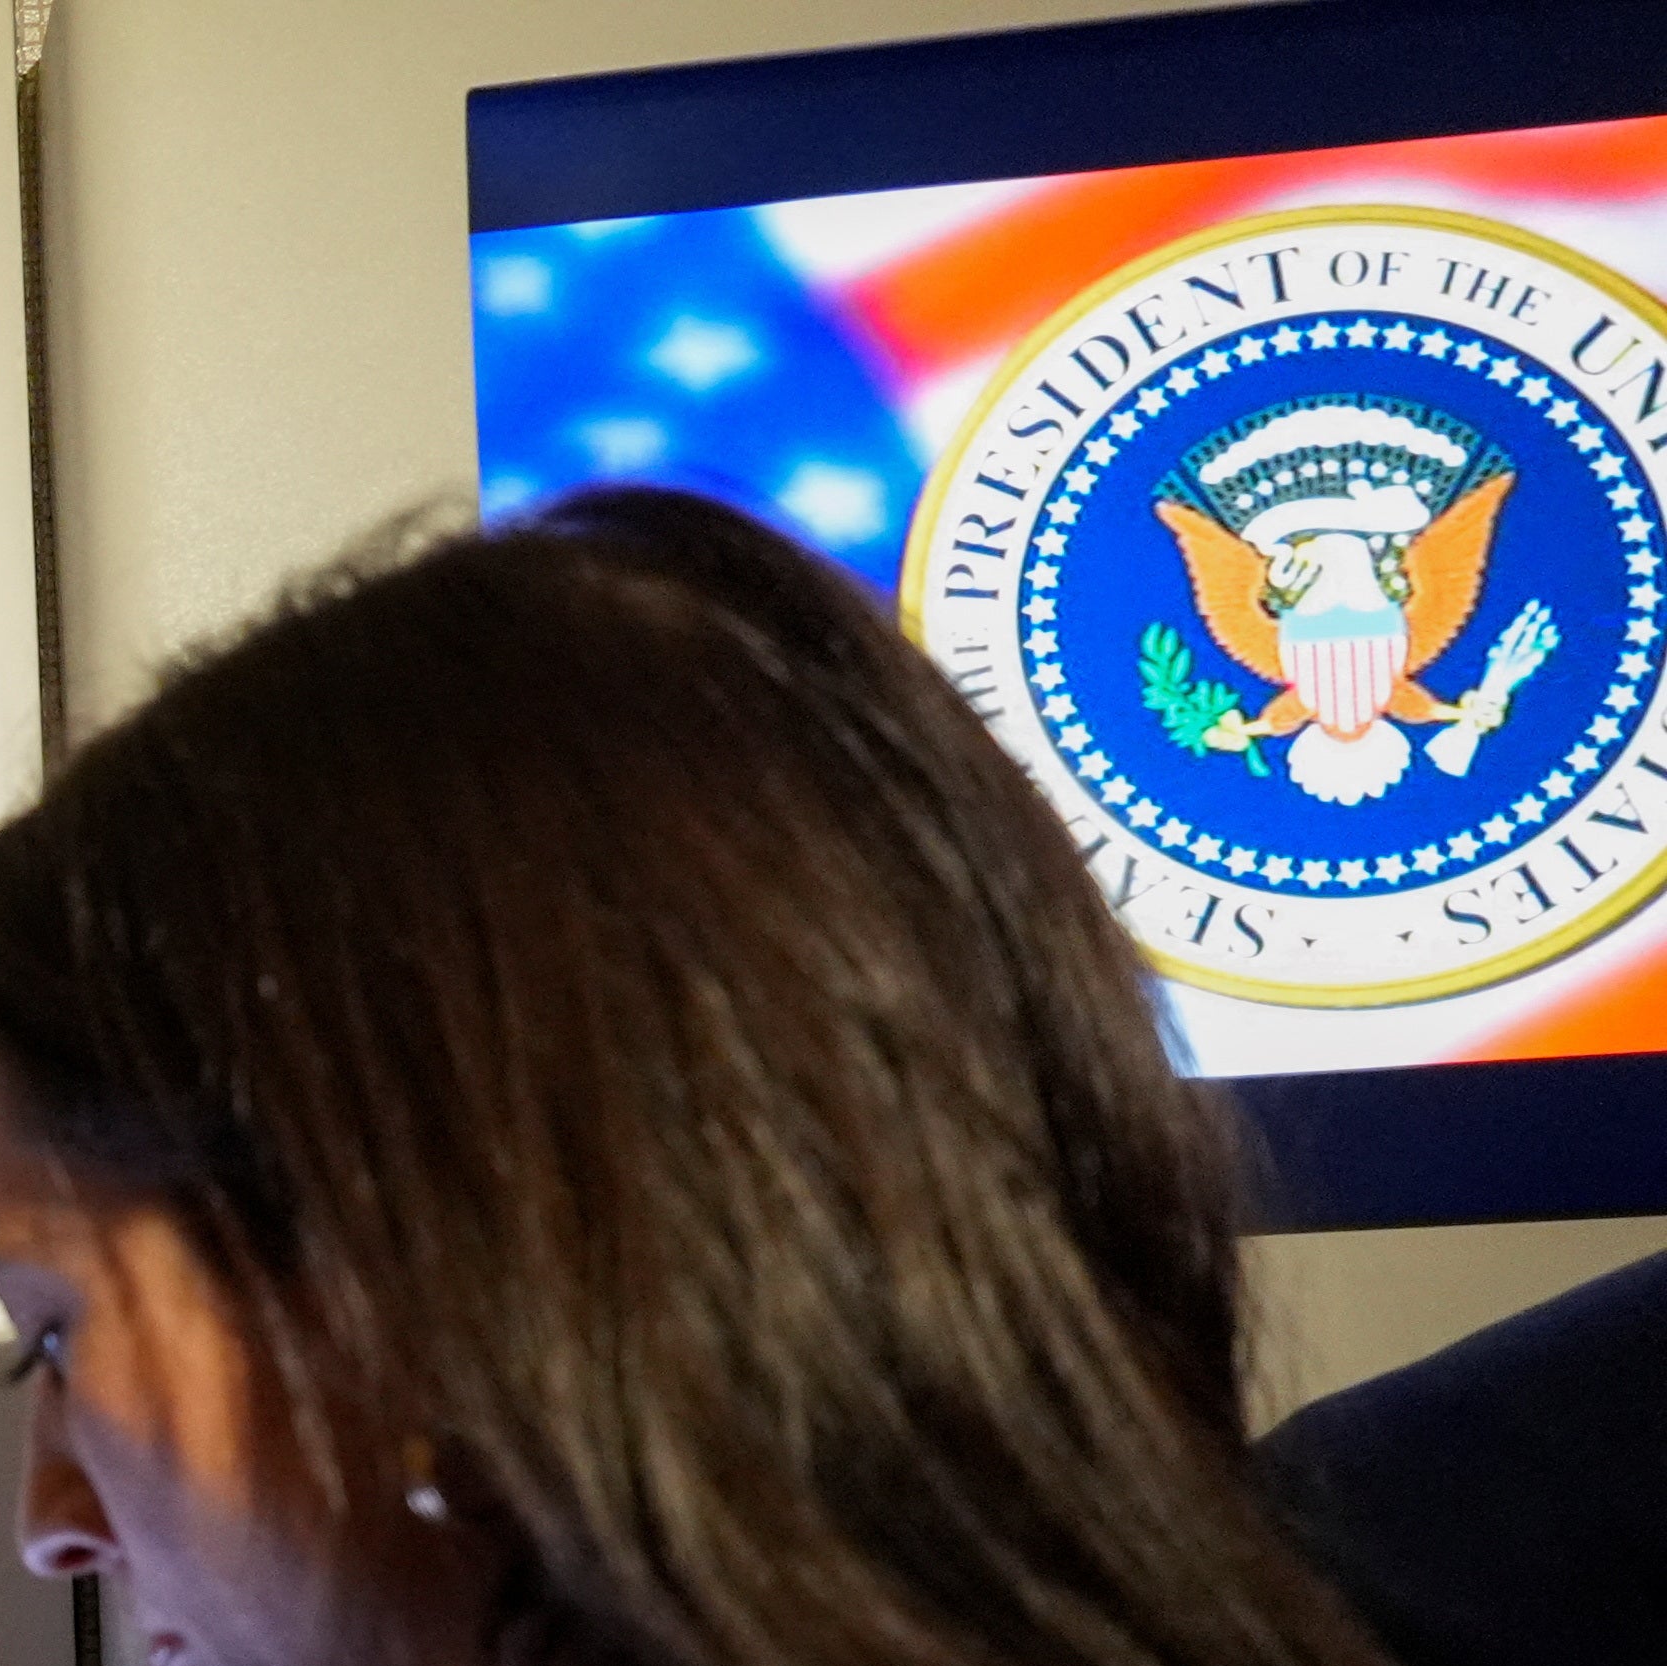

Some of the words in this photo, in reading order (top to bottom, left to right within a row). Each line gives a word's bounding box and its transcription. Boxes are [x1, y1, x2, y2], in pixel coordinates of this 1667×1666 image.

[943, 246, 1300, 600] PRESIDENT
[1328, 250, 1411, 287] OF
[1436, 257, 1552, 326] THE
